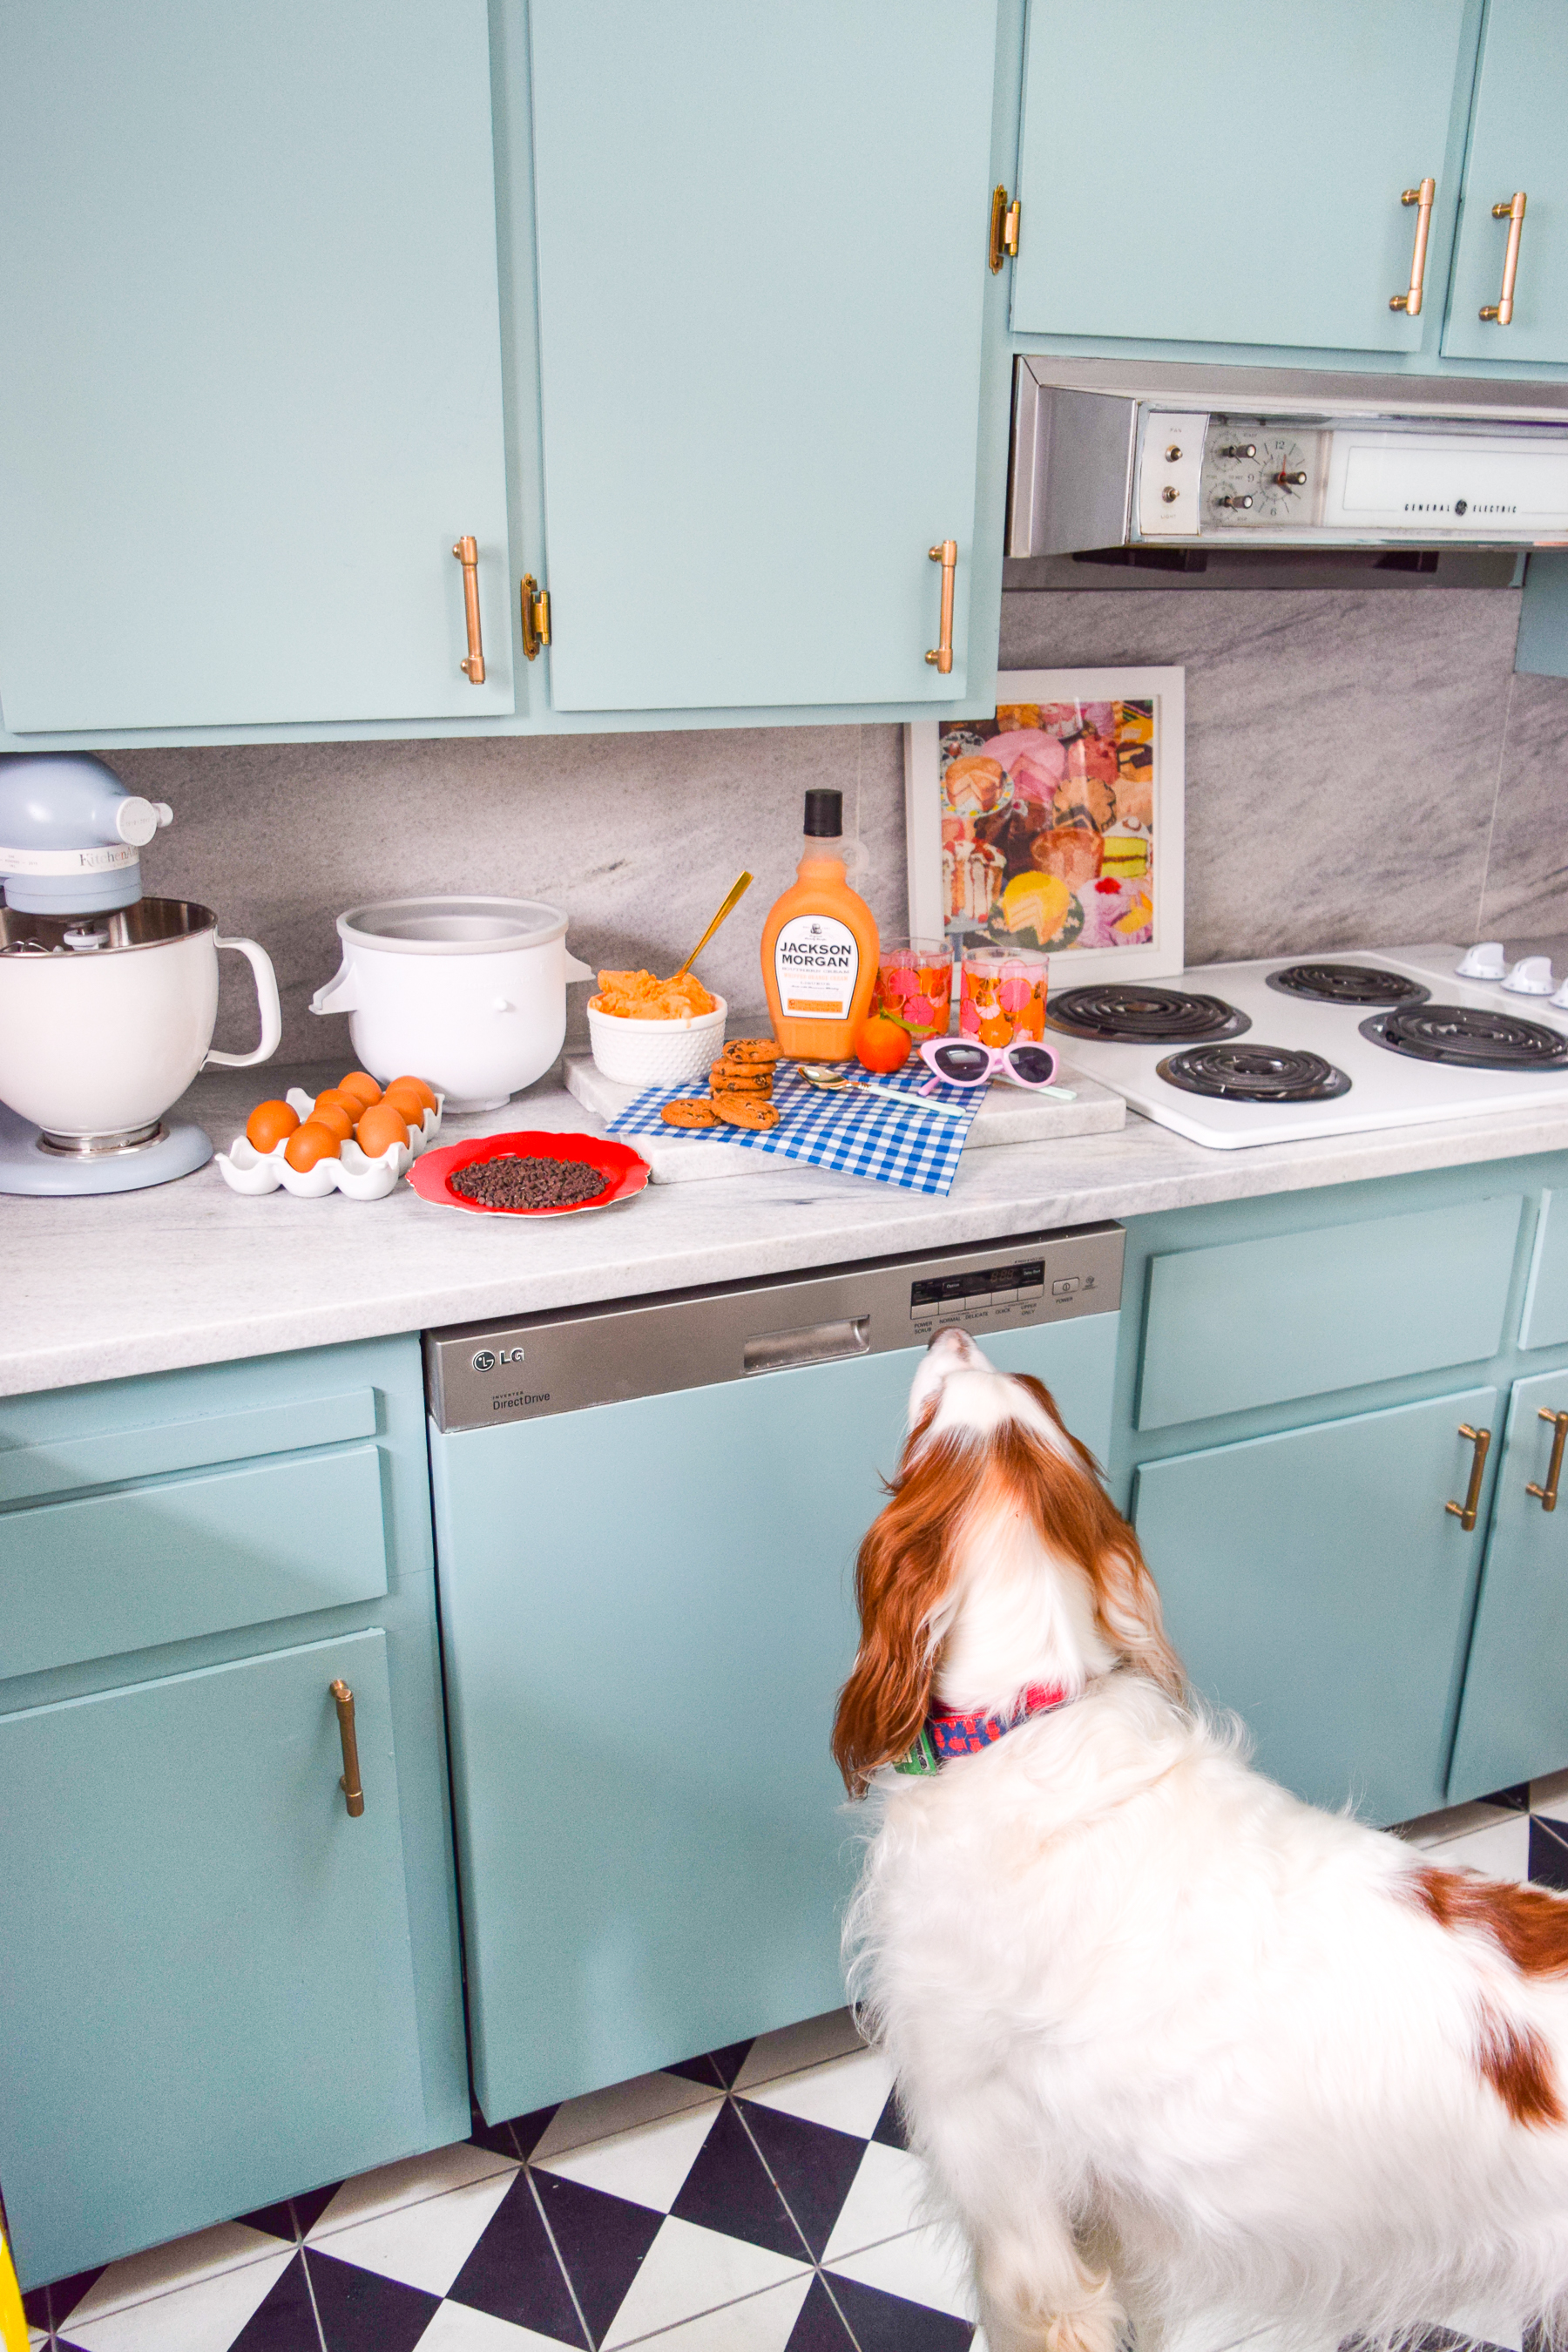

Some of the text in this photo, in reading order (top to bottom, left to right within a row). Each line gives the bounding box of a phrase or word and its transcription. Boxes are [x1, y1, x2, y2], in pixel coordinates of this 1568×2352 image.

[1274, 440, 1285, 449] 12
[1247, 474, 1254, 483] 9
[1270, 507, 1277, 516] 6
[1404, 504, 1450, 512] GENERAL
[781, 942, 851, 955] JACKSON
[782, 955, 849, 967] MORGAN
[965, 1311, 989, 1320] DELICATE
[499, 1348, 524, 1365] LG
[492, 1390, 524, 1400] INVERTER
